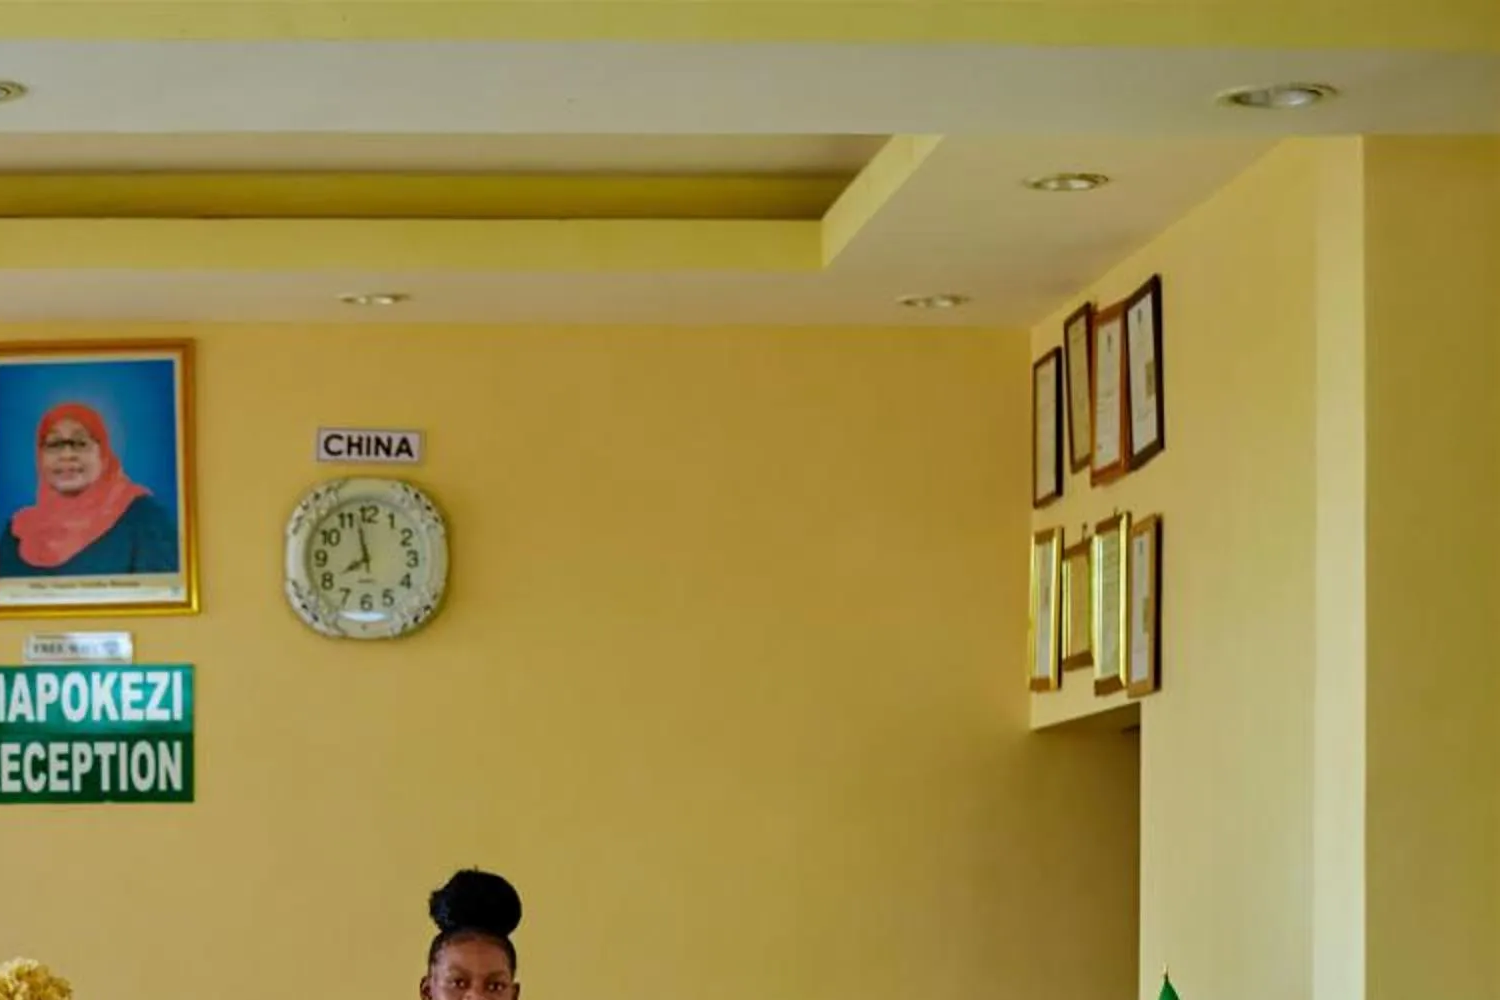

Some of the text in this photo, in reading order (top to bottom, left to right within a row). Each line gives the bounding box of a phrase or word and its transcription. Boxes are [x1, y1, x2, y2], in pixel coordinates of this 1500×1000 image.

[323, 433, 414, 458] CHINA
[339, 513, 353, 528] 11
[360, 506, 379, 524] 12
[388, 513, 395, 529] 1
[321, 528, 340, 546] 10
[400, 529, 413, 547] 2
[314, 550, 327, 568] 9
[406, 550, 419, 568] 3
[321, 572, 333, 590] 8
[400, 574, 411, 589] 4
[339, 588, 351, 605] 7
[360, 594, 373, 611] 6
[382, 589, 394, 607] 5
